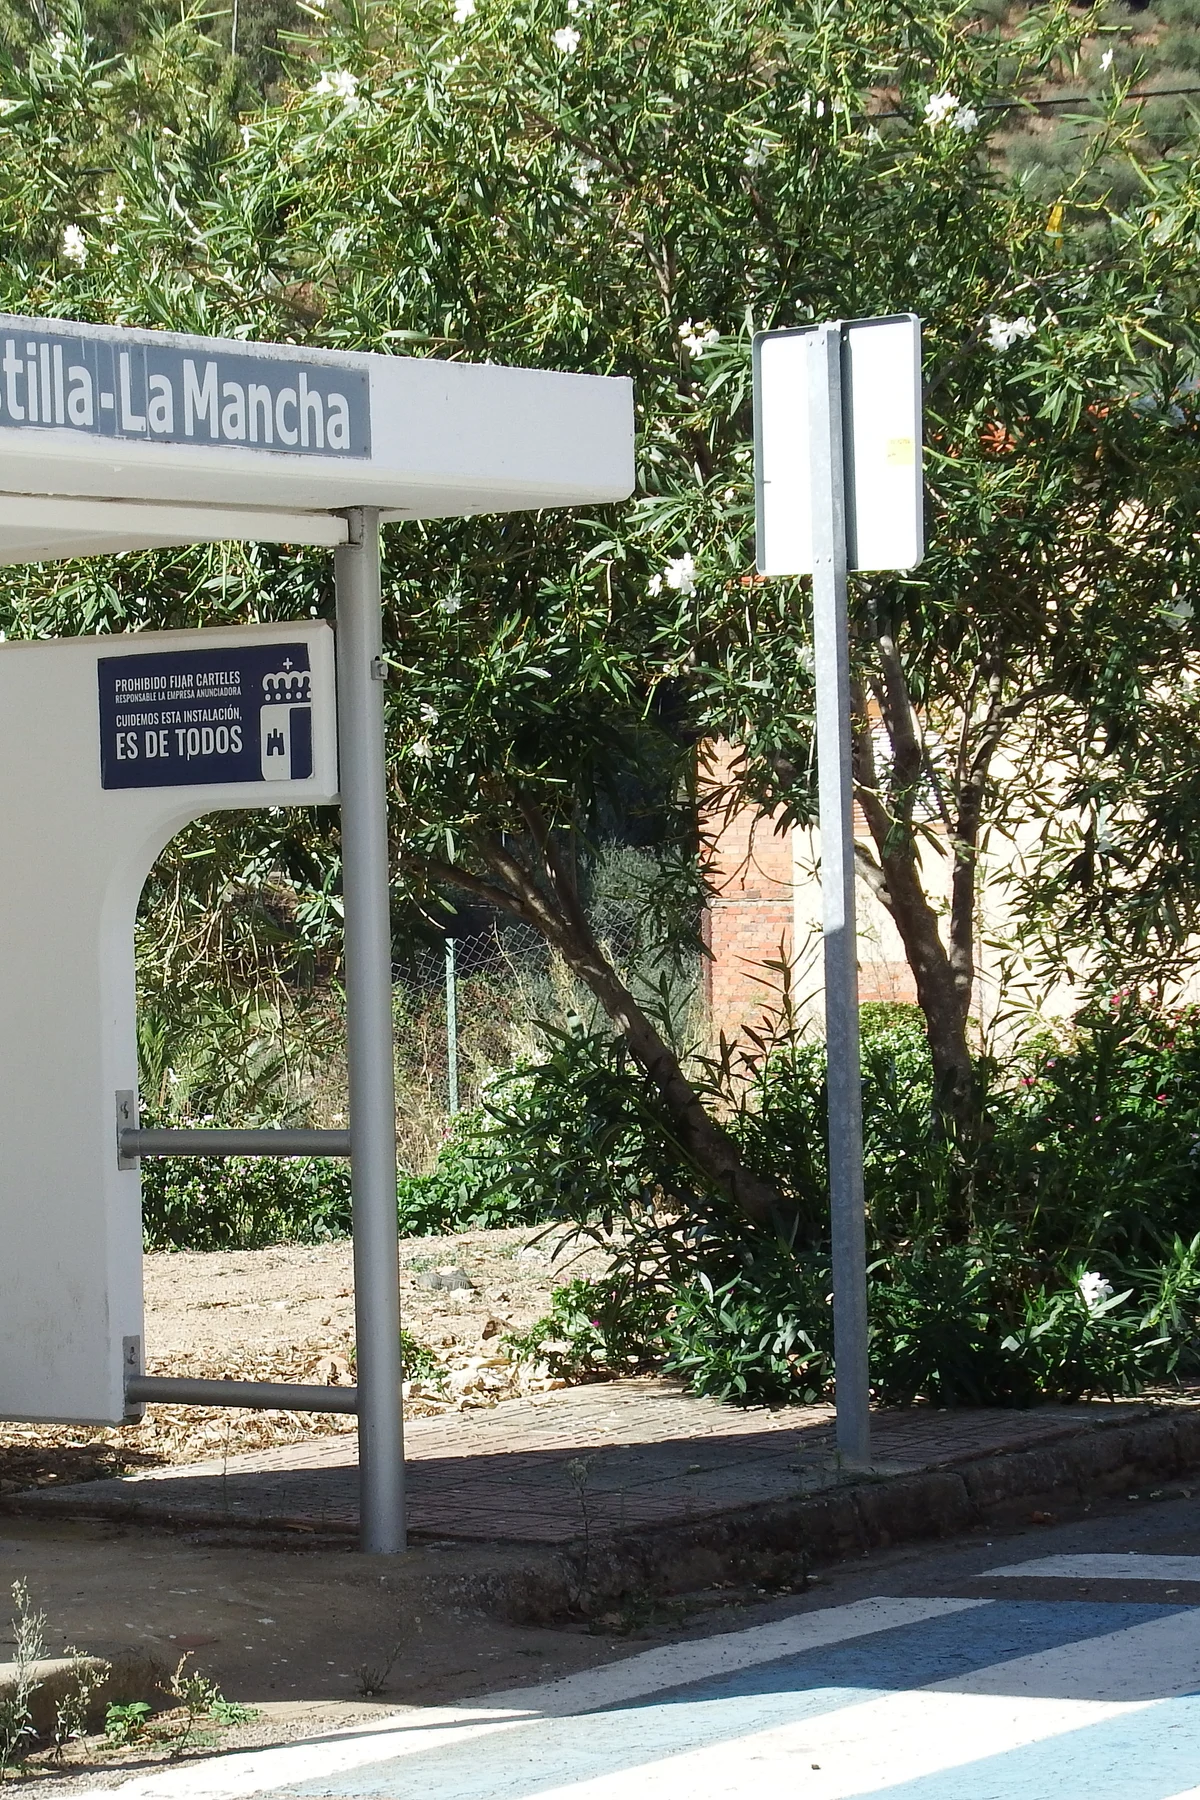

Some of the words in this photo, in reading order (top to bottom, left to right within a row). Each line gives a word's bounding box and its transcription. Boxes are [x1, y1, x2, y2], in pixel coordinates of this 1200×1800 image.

[183, 358, 350, 450] Mancha
[115, 676, 167, 692] PROHIBIDO
[169, 673, 193, 690] FIJAR
[196, 671, 241, 687] CARTELES
[115, 691, 157, 704] RESPONSABLE
[158, 691, 166, 701] LA
[167, 689, 195, 701] EMPRESA
[196, 686, 242, 698] ANUNCIADORA
[116, 712, 159, 727] CUIDEMOS
[161, 710, 181, 724] ESTA
[184, 704, 243, 722] INSTALACIÓN,
[116, 731, 139, 760] ES
[145, 729, 169, 758] DE
[175, 725, 243, 758] TODOS
